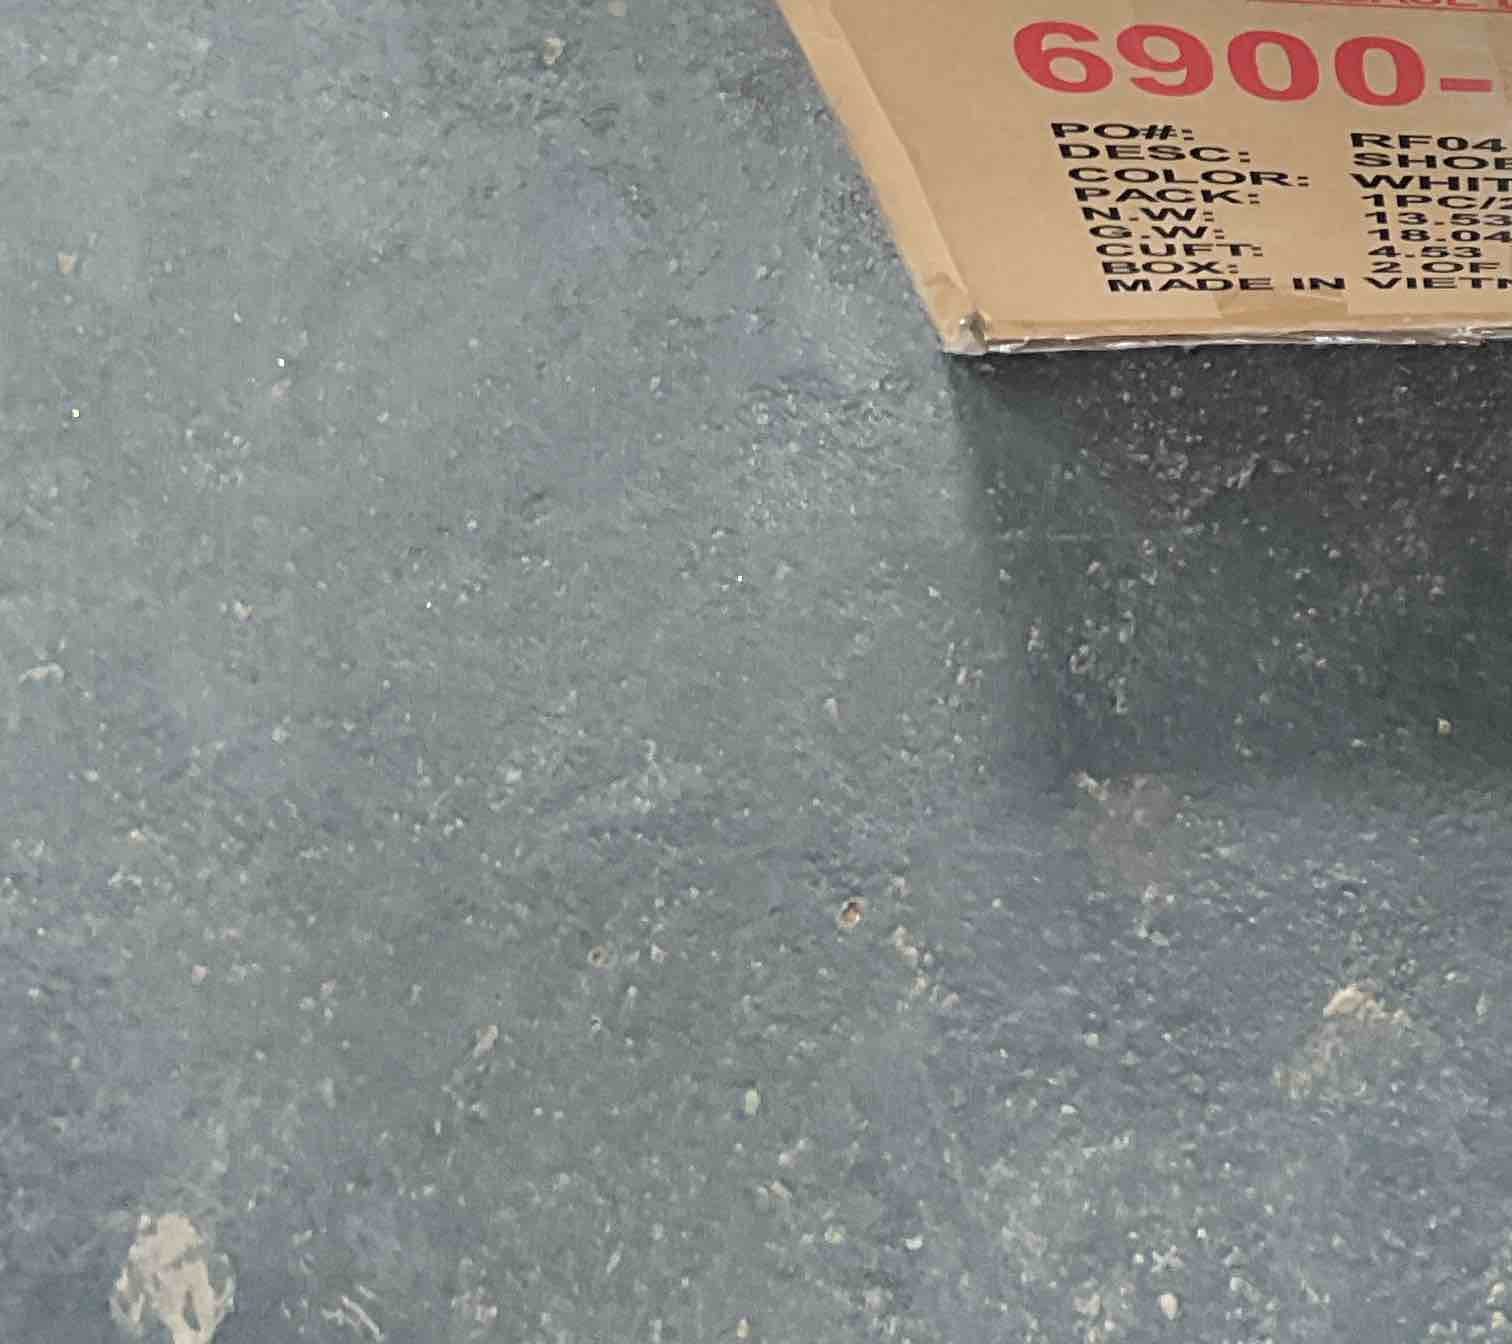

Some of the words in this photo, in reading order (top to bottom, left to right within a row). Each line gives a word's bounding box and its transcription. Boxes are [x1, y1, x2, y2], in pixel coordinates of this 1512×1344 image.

[1050, 122, 1195, 141] PO#:
[1058, 144, 1251, 163] DESC:
[1068, 167, 1309, 187] COLOR:
[1074, 187, 1260, 204] PACK:
[1081, 207, 1214, 222] N.W:
[1095, 243, 1263, 257] CUFT:
[1367, 245, 1482, 258] 4.53
[1101, 261, 1239, 274] BOX:
[1371, 262, 1403, 274] 2
[1421, 262, 1501, 274] OF
[1107, 278, 1275, 292] MADE
[1292, 277, 1346, 291] IN
